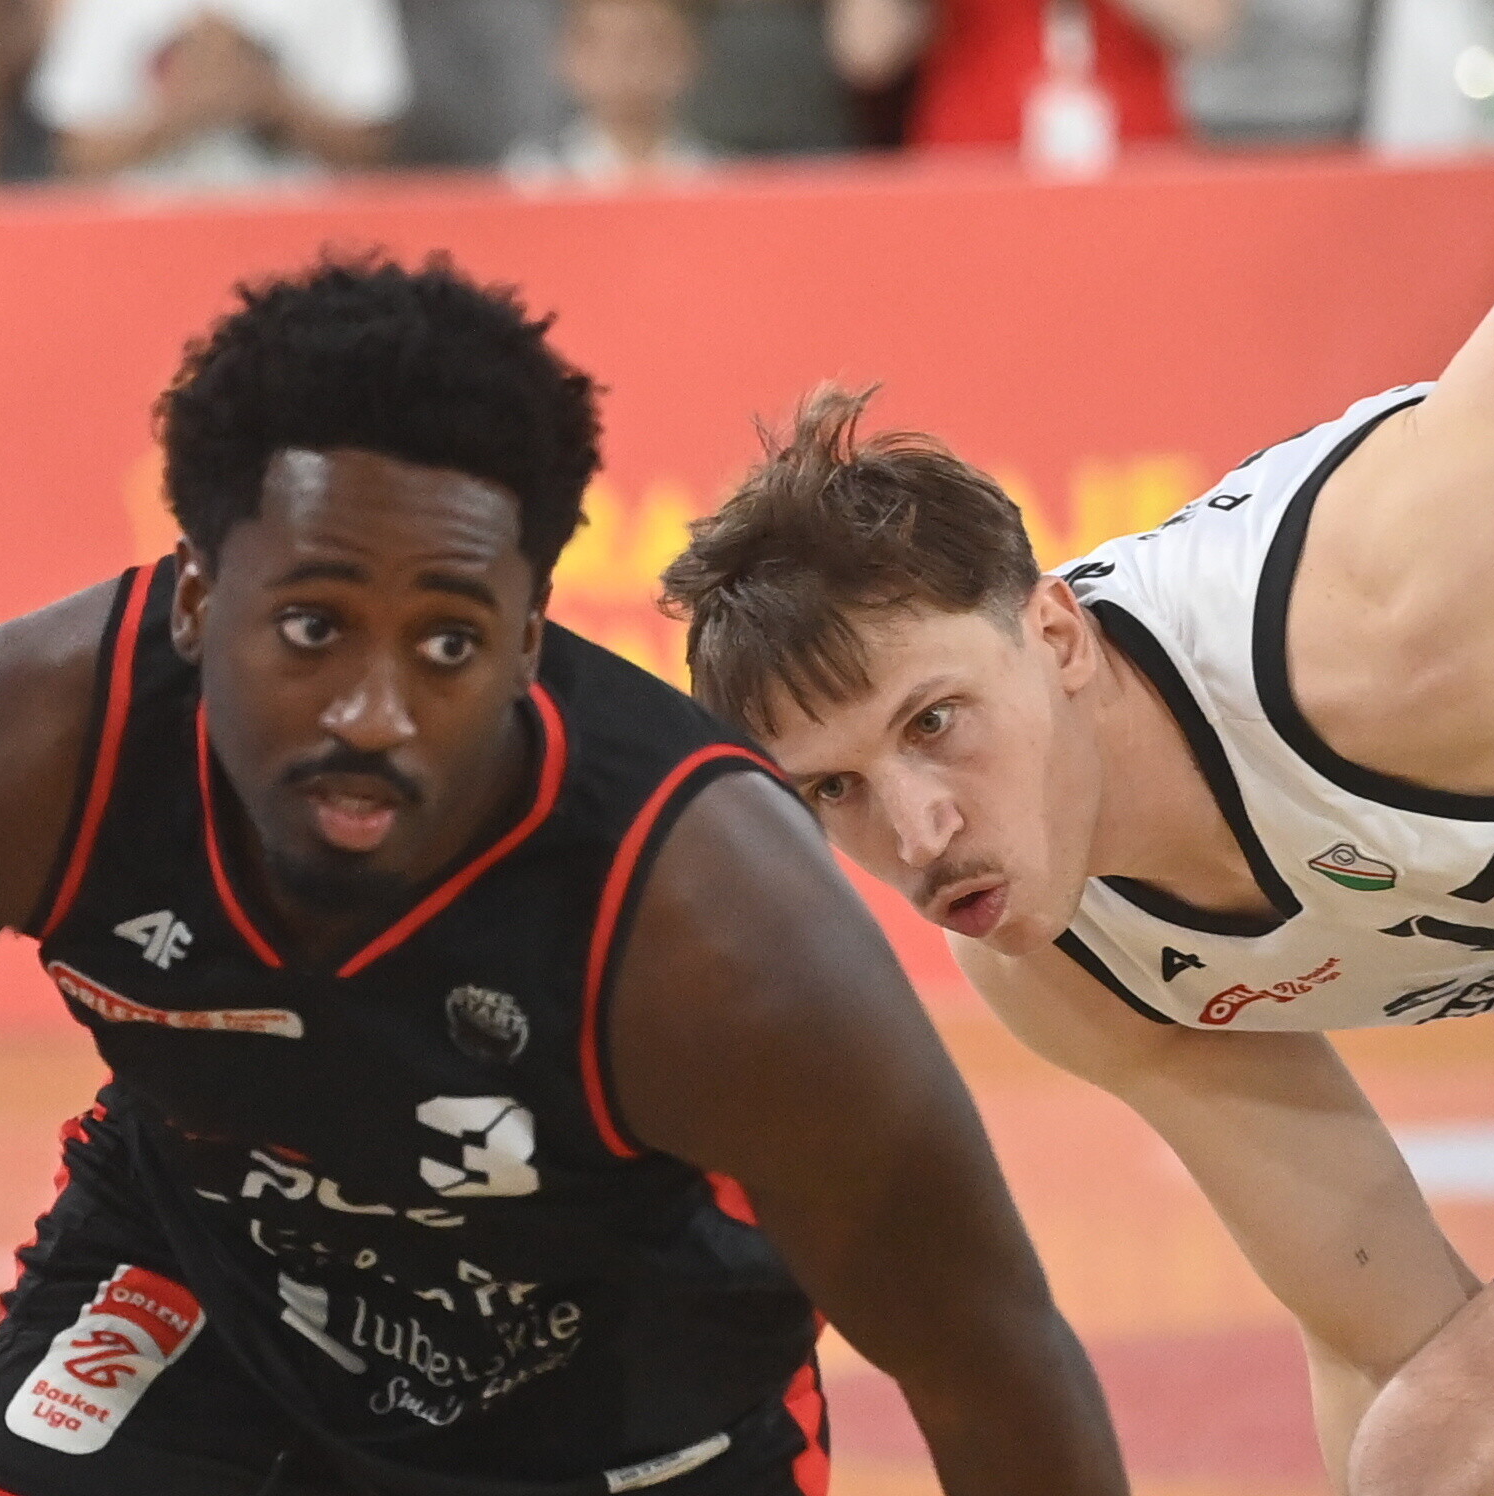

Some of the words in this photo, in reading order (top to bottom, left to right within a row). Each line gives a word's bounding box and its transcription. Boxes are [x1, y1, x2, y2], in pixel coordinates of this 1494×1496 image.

[113, 909, 194, 970] 4F
[415, 1096, 540, 1197] 3
[113, 1287, 189, 1332] ORLEN
[32, 1380, 111, 1423] Basket
[33, 1402, 82, 1431] Liga
